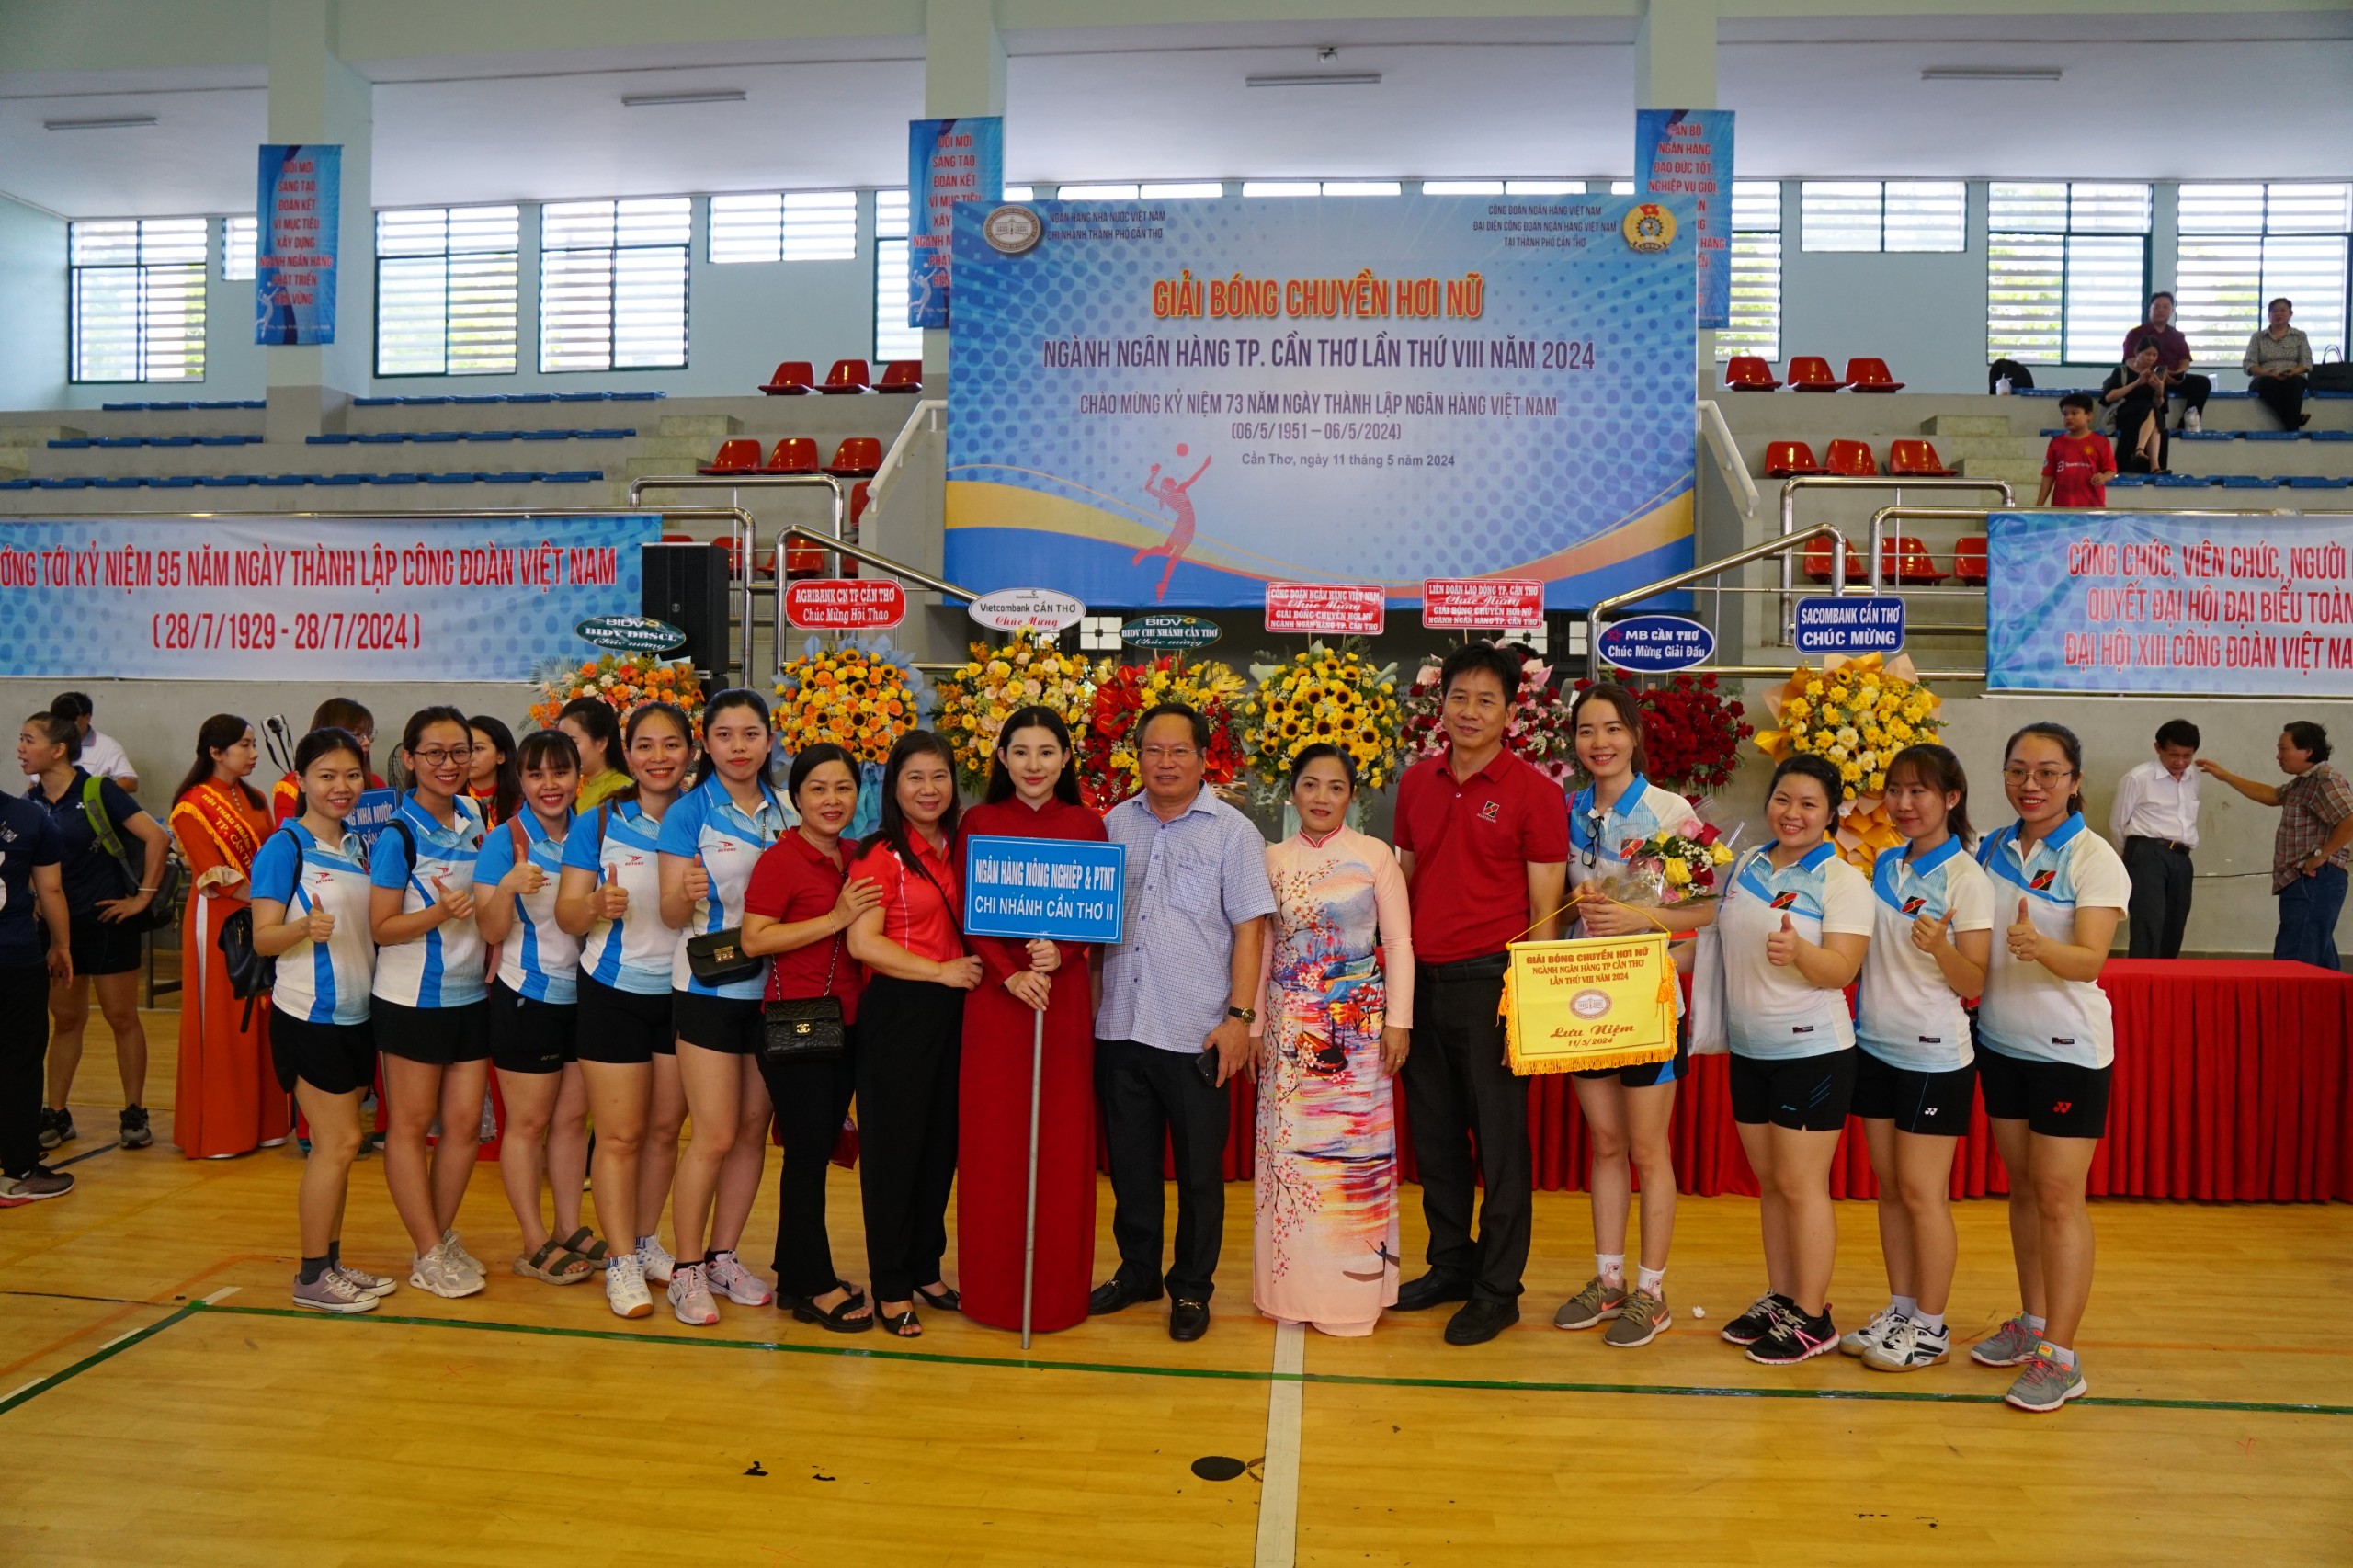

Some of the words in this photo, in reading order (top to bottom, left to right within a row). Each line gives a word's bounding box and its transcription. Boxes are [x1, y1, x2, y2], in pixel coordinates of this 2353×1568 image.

[1586, 207, 1601, 216] NAM
[1153, 268, 1202, 317] GIẢI
[1210, 272, 1278, 317] BÓNG
[1286, 268, 1388, 317] CHUYỀN
[1395, 278, 1438, 316] HƠI
[1447, 272, 1484, 318] NỮ
[1043, 335, 1110, 368] NGÀNH
[1117, 335, 1170, 367] NGÂN
[1176, 335, 1230, 367] HÀNG
[1236, 339, 1266, 367] TP.
[1272, 331, 1311, 367] CẦN
[1317, 337, 1358, 367] THƠ
[1362, 331, 1401, 367] LẦN
[1407, 335, 1447, 368] THỨ
[1452, 340, 1483, 368] VIII
[1491, 335, 1535, 369] NĂM
[1541, 340, 1595, 369] 2024
[1080, 392, 1117, 414] CHÀO
[1120, 391, 1160, 414] MỪNG
[1165, 388, 1183, 414] KỶ
[1187, 391, 1222, 418] NIỆM
[1226, 393, 1243, 414] 73
[1247, 390, 1279, 414] NĂM
[1283, 391, 1320, 414] NGÀY
[1324, 391, 1371, 414] THÀNH
[1376, 391, 1403, 418] LẬP
[1405, 392, 1444, 415] NGÂN
[1449, 392, 1486, 415] HÀNG
[1491, 392, 1521, 419] VIỆT
[1526, 397, 1557, 416] NAM
[1242, 451, 1265, 465] Cần
[1269, 453, 1296, 467] Thơ,
[1300, 453, 1328, 468] ngày
[1333, 455, 1345, 465] 11
[1349, 454, 1383, 468] tháng
[1387, 455, 1394, 465] 5
[1398, 455, 1423, 466] năm
[1427, 455, 1455, 467] 2024
[41, 544, 70, 586] TỚI
[75, 540, 99, 586] KỶ
[105, 544, 151, 595] NIỆM
[157, 551, 181, 586] 95
[187, 543, 229, 586] NĂM
[234, 543, 285, 586] NGÀY
[291, 543, 355, 586] THÀNH
[361, 541, 397, 594] LẬP
[403, 541, 454, 586] CÔNG
[460, 540, 514, 585] ĐOÀN
[519, 540, 564, 594] VIỆT
[569, 545, 617, 585] NAM
[2068, 536, 2117, 577] CÔNG
[2121, 538, 2177, 582] CHỨC,
[2182, 539, 2224, 578] VIÊN
[2230, 540, 2285, 583] CHỨC,
[2290, 541, 2346, 579] NGƯỜI
[795, 588, 835, 603] AGRIBANK
[837, 588, 848, 603] CN
[849, 589, 859, 602] TP
[860, 584, 877, 603] CẦN
[878, 587, 895, 603] THƠ
[980, 603, 1029, 613] Vietcombank
[1056, 603, 1076, 613] THƠ
[1802, 607, 1858, 624] SACOMBANK
[1859, 600, 1879, 623] CẦN
[1881, 605, 1901, 623] THƠ
[2087, 581, 2147, 622] QUYẾT
[2152, 590, 2182, 629] ĐẠI
[2188, 584, 2219, 629] HỘI
[2224, 590, 2256, 630] ĐẠI
[2261, 578, 2302, 624] BIỂU
[606, 618, 644, 628] BIDV
[803, 607, 824, 621] Chúc
[826, 608, 848, 624] Mừng
[851, 607, 865, 624] Hội
[868, 608, 889, 621] Thao
[995, 616, 1023, 625] Chúc
[1029, 616, 1059, 628] Mừng
[585, 627, 623, 637] BIDV
[1625, 630, 1648, 641] MB
[1651, 627, 1673, 641] CẦN
[1676, 630, 1699, 641] THƠ
[1802, 628, 1846, 646] CHÚC
[1850, 628, 1896, 645] MỪNG
[1608, 645, 1632, 657] Chúc
[1635, 645, 1662, 659] Mừng
[1665, 644, 1683, 657] Giải
[1686, 644, 1705, 657] Đấu
[2065, 632, 2096, 672] ĐẠI
[2100, 627, 2131, 673] HỘI
[2136, 634, 2167, 667] XIII
[2173, 629, 2220, 668] CÔNG
[2226, 629, 2277, 669] ĐOÀN
[2282, 631, 2324, 676] VIỆT
[975, 855, 999, 884] NGÂN
[1000, 856, 1023, 886] HÀNG
[1026, 858, 1049, 888] NÔNG
[1051, 859, 1082, 894] NGHIỆP
[1084, 866, 1091, 890] &
[1093, 866, 1116, 891] PTNT
[974, 895, 995, 914] CHI
[999, 894, 1043, 916] NHÁNH
[1046, 894, 1073, 918] CẦN
[1076, 902, 1103, 920] THƠ
[1106, 903, 1114, 920] II
[1526, 954, 1546, 964] GIẢI
[1548, 952, 1574, 963] BÓNG
[1616, 949, 1632, 959] HƠI
[1532, 965, 1558, 975] NGÀNH
[1559, 963, 1579, 974] NGÂN
[1581, 960, 1601, 972] HÀNG
[1602, 962, 1611, 971] TP
[1629, 959, 1644, 968] THƠ
[1565, 974, 1581, 985] THỨ
[1582, 974, 1594, 983] VIII
[1596, 972, 1610, 983] NĂM
[1612, 971, 1629, 982] 2024
[1550, 1027, 1584, 1038] Lưu
[1591, 1024, 1635, 1037] Niệm
